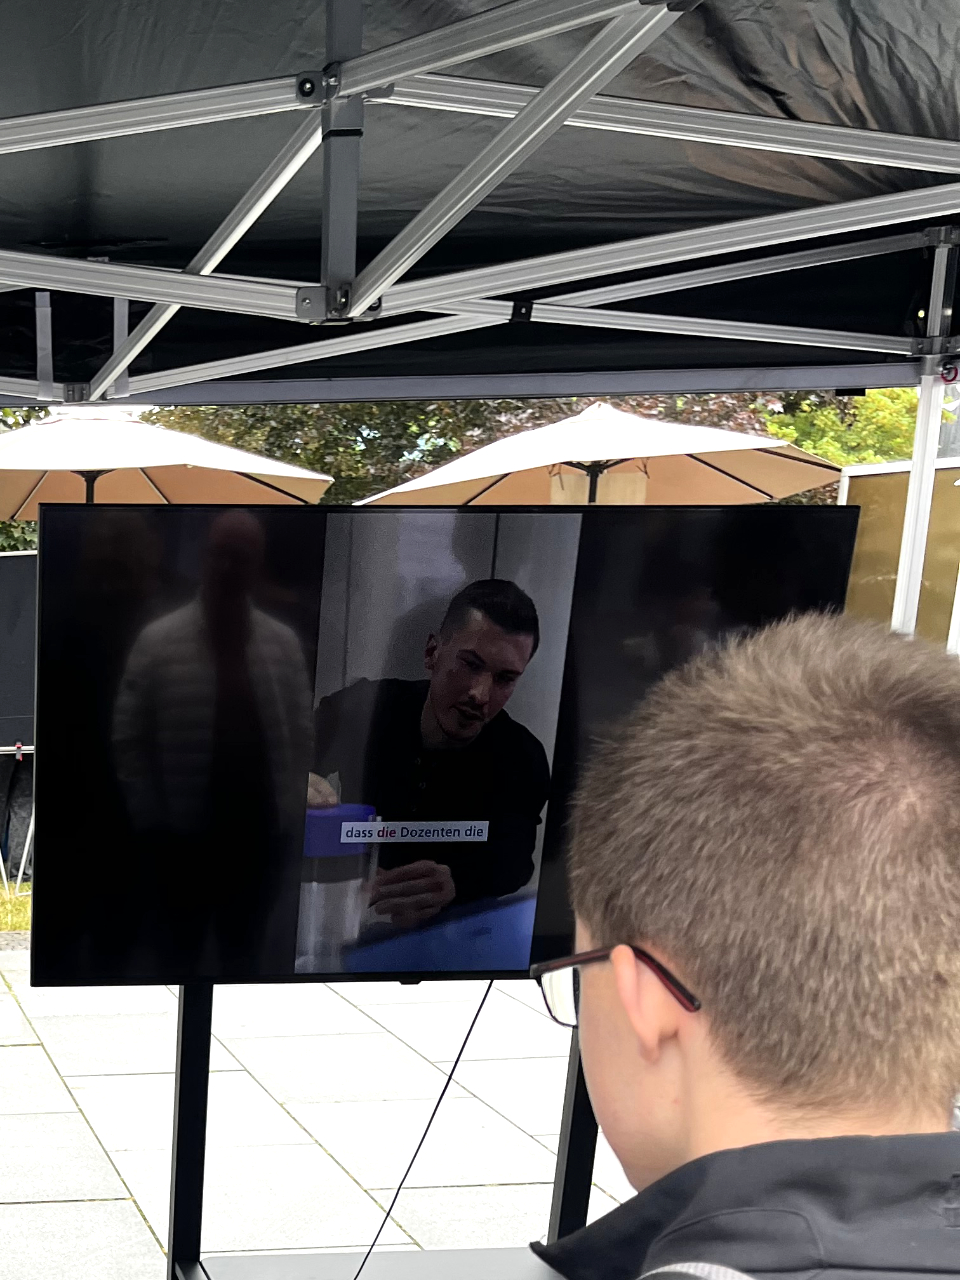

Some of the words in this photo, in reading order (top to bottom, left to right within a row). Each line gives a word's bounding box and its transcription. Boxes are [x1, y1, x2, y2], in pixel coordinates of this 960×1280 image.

[345, 827, 373, 838] dass
[377, 826, 397, 838] die
[400, 826, 461, 838] Dozenten
[464, 826, 484, 837] die
